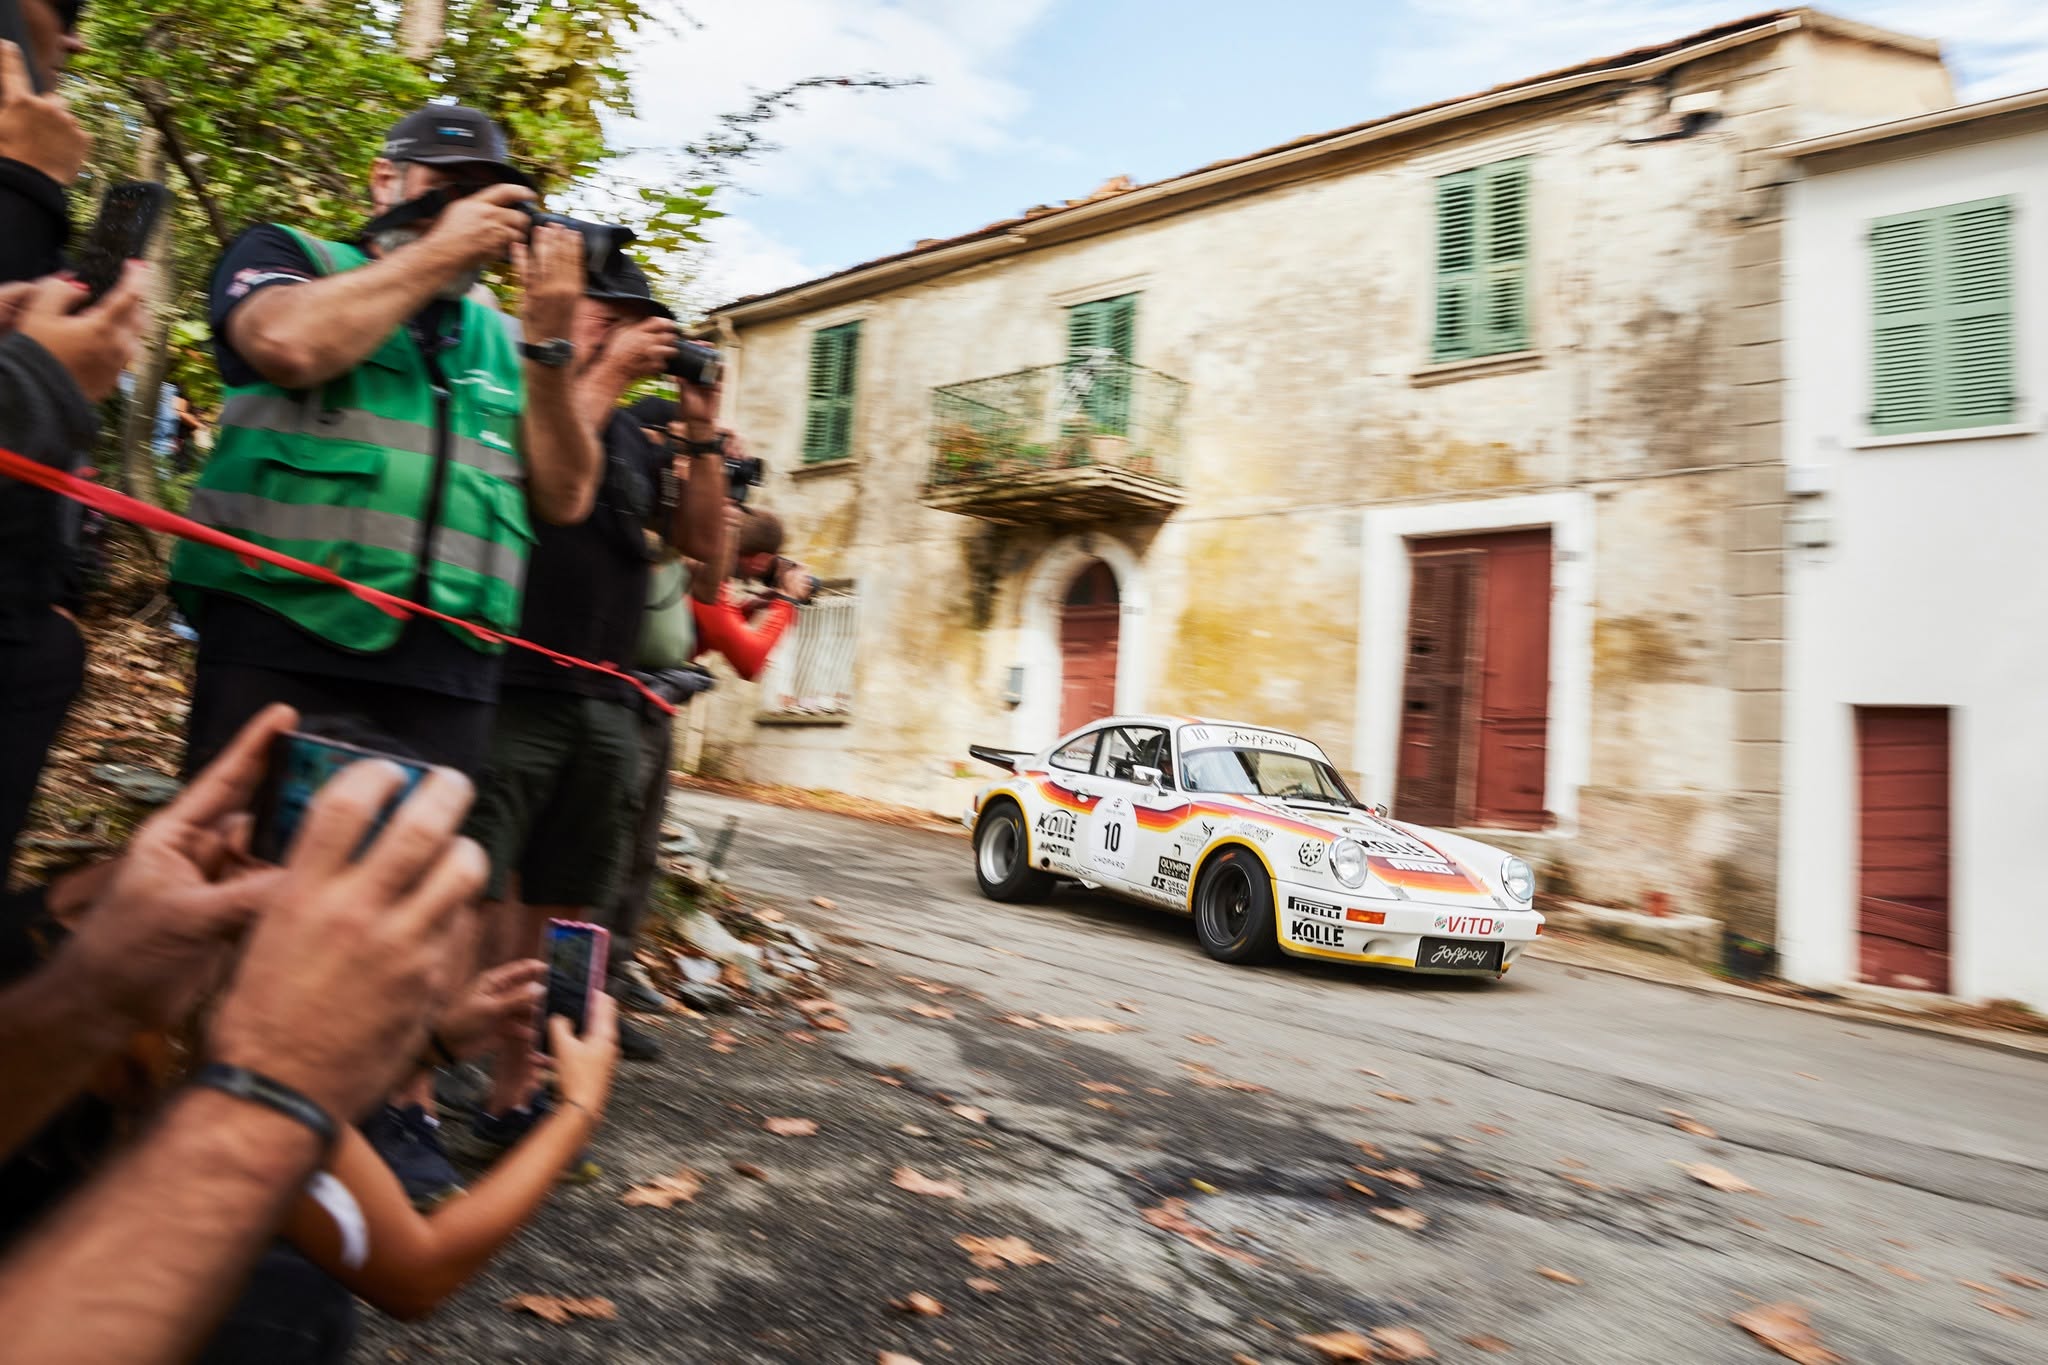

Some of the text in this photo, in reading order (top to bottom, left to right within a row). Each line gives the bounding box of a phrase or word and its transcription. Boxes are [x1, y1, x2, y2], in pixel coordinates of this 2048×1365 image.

[1191, 728, 1209, 741] 10
[1104, 821, 1121, 852] 10
[1160, 858, 1190, 875] OLYMPIC
[1288, 896, 1342, 920] PIRELLI
